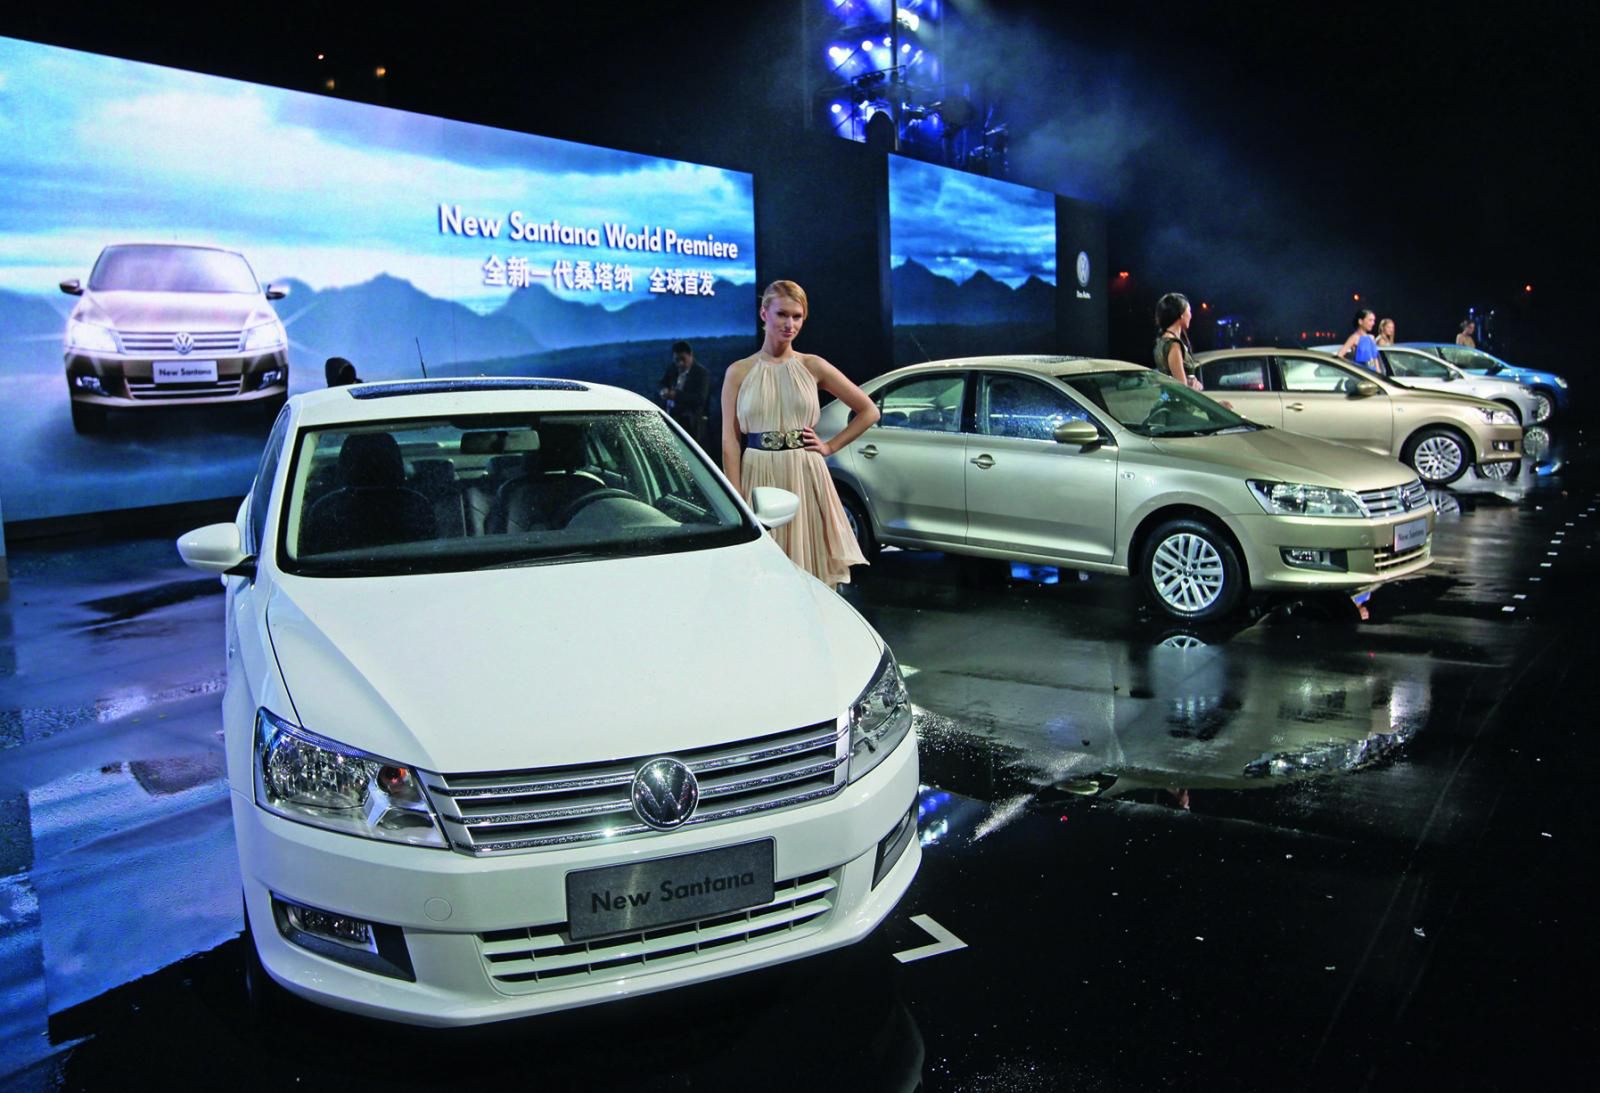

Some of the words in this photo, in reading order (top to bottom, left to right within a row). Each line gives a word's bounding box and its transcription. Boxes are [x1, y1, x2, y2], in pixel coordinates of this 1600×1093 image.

[439, 204, 502, 238] New
[508, 211, 600, 247] Santana
[604, 222, 661, 252] World
[665, 229, 738, 259] Premiere
[482, 255, 633, 292] 全新一代桑塔纳
[649, 267, 715, 296] 全球首发
[159, 368, 178, 376] New
[181, 367, 213, 376] Santana
[591, 890, 650, 913] New
[660, 871, 754, 902] Santana
